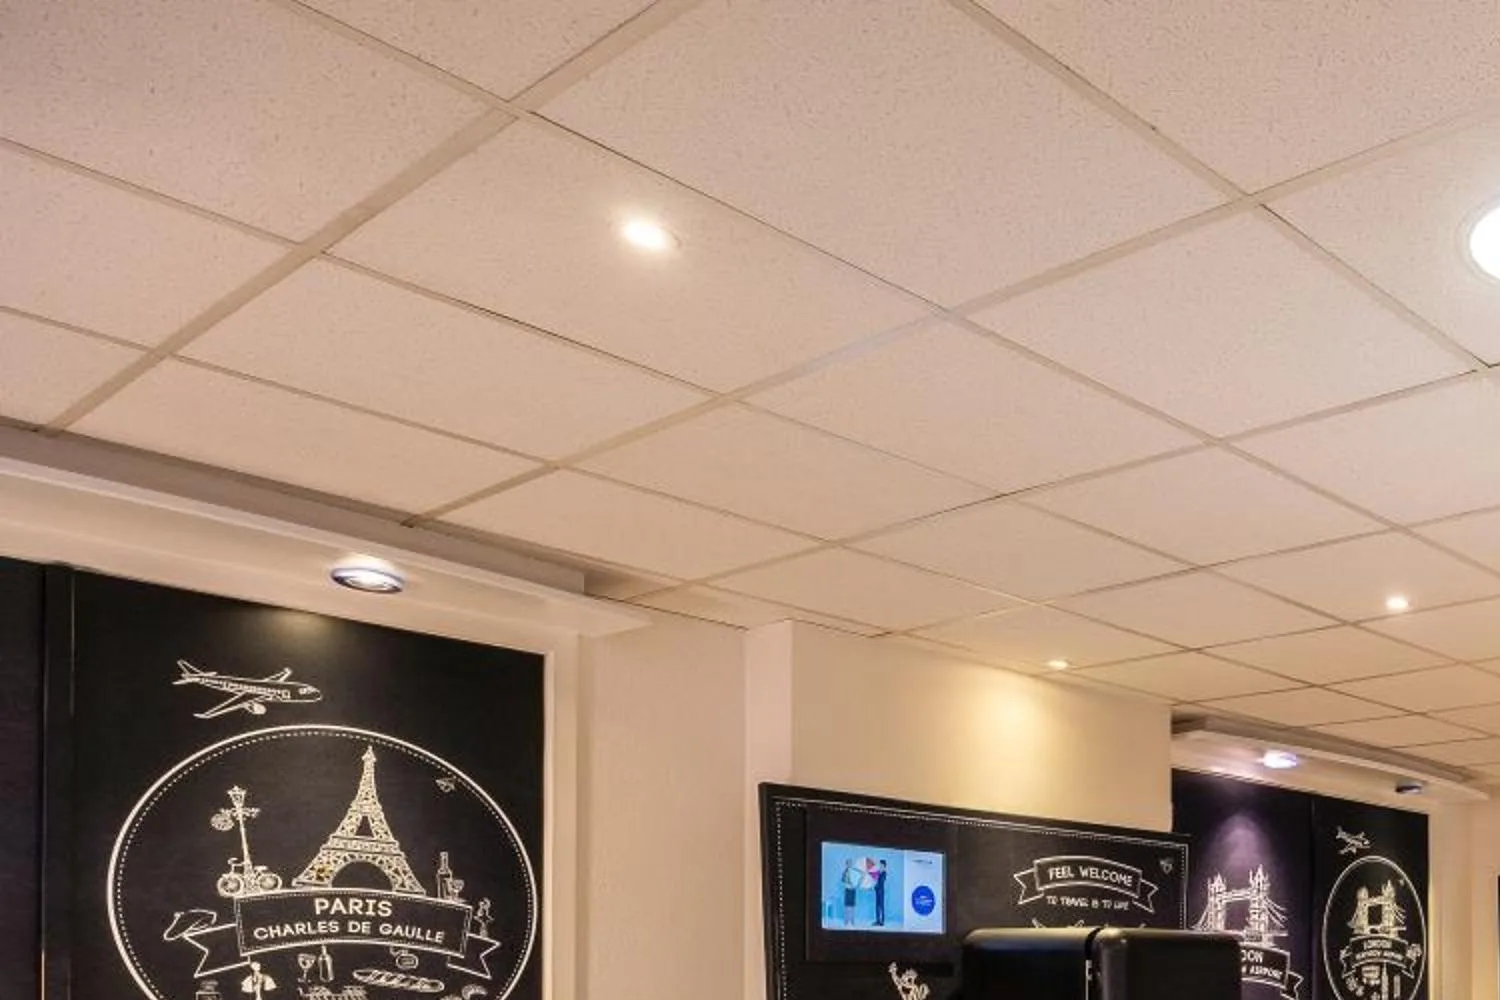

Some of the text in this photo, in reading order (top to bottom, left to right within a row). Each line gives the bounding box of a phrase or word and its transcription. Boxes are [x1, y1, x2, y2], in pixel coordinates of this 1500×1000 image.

[1048, 865, 1133, 887] FEEL WELCOME
[314, 897, 393, 917] PARIS
[253, 920, 446, 944] CHARLES DE GAULLE
